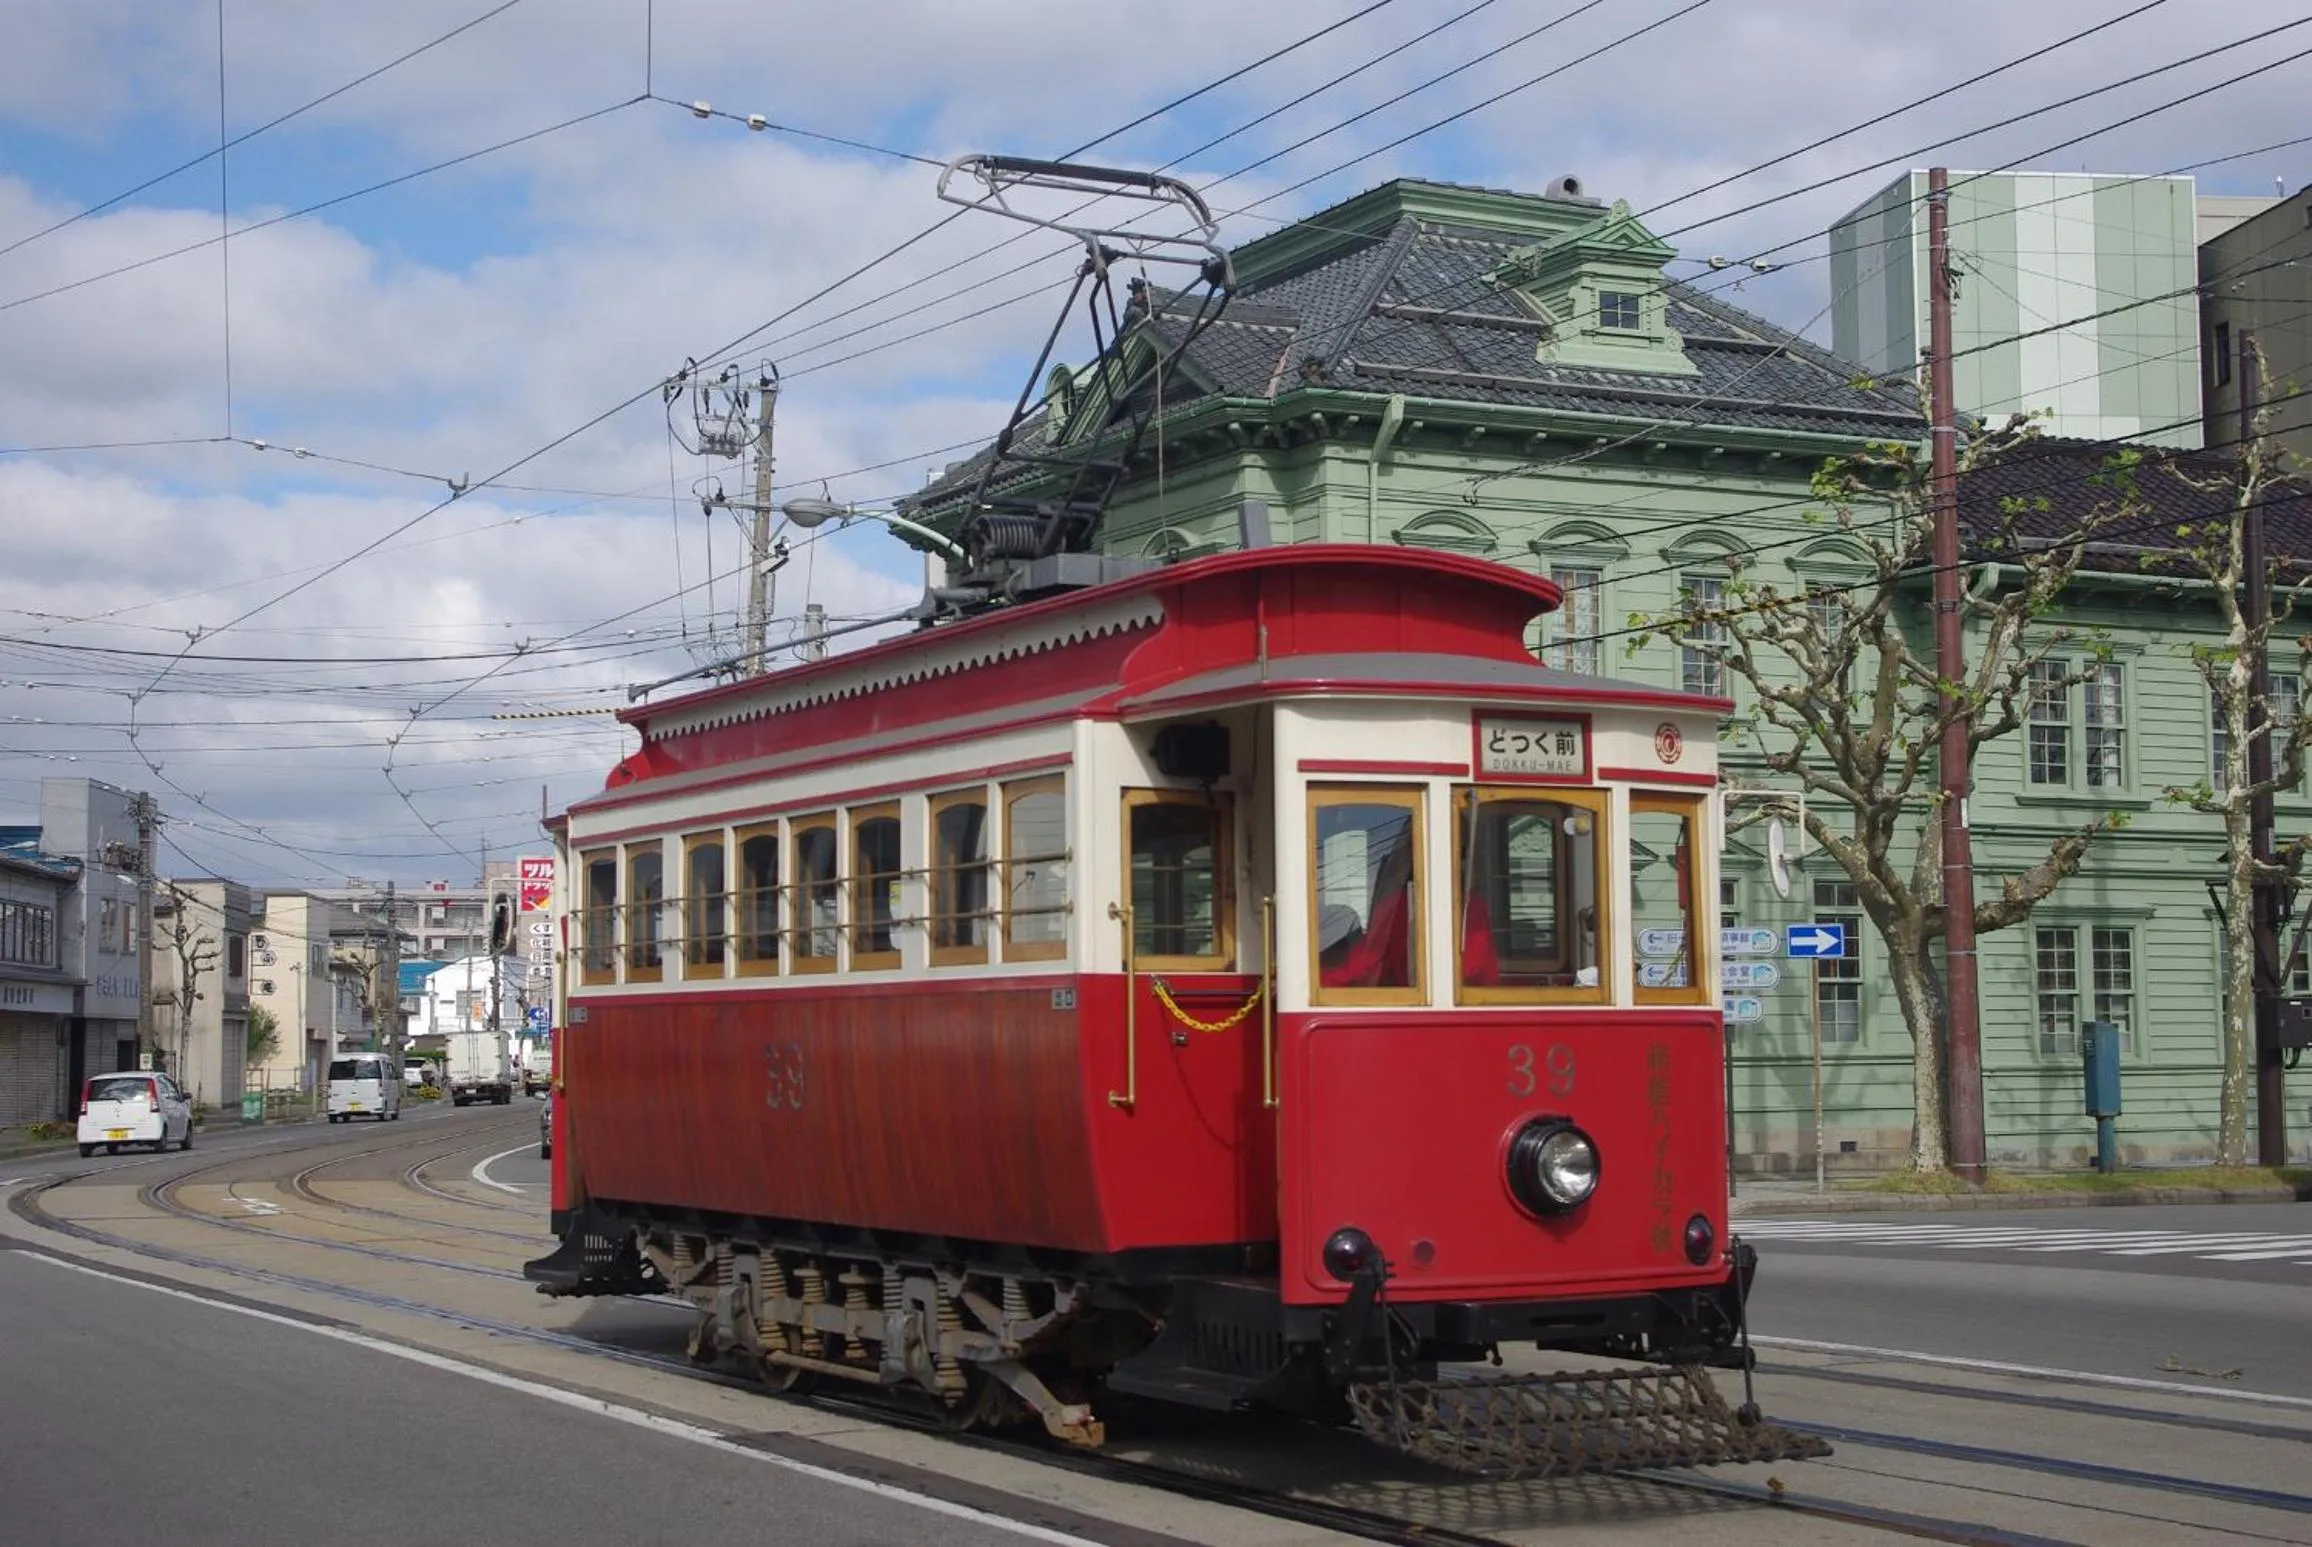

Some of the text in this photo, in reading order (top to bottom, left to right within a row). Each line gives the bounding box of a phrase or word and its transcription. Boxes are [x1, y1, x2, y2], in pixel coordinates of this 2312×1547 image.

[1488, 727, 1576, 756] どつく前
[1492, 758, 1573, 772] DOKKU-MAE
[1505, 1043, 1577, 1098] 39
